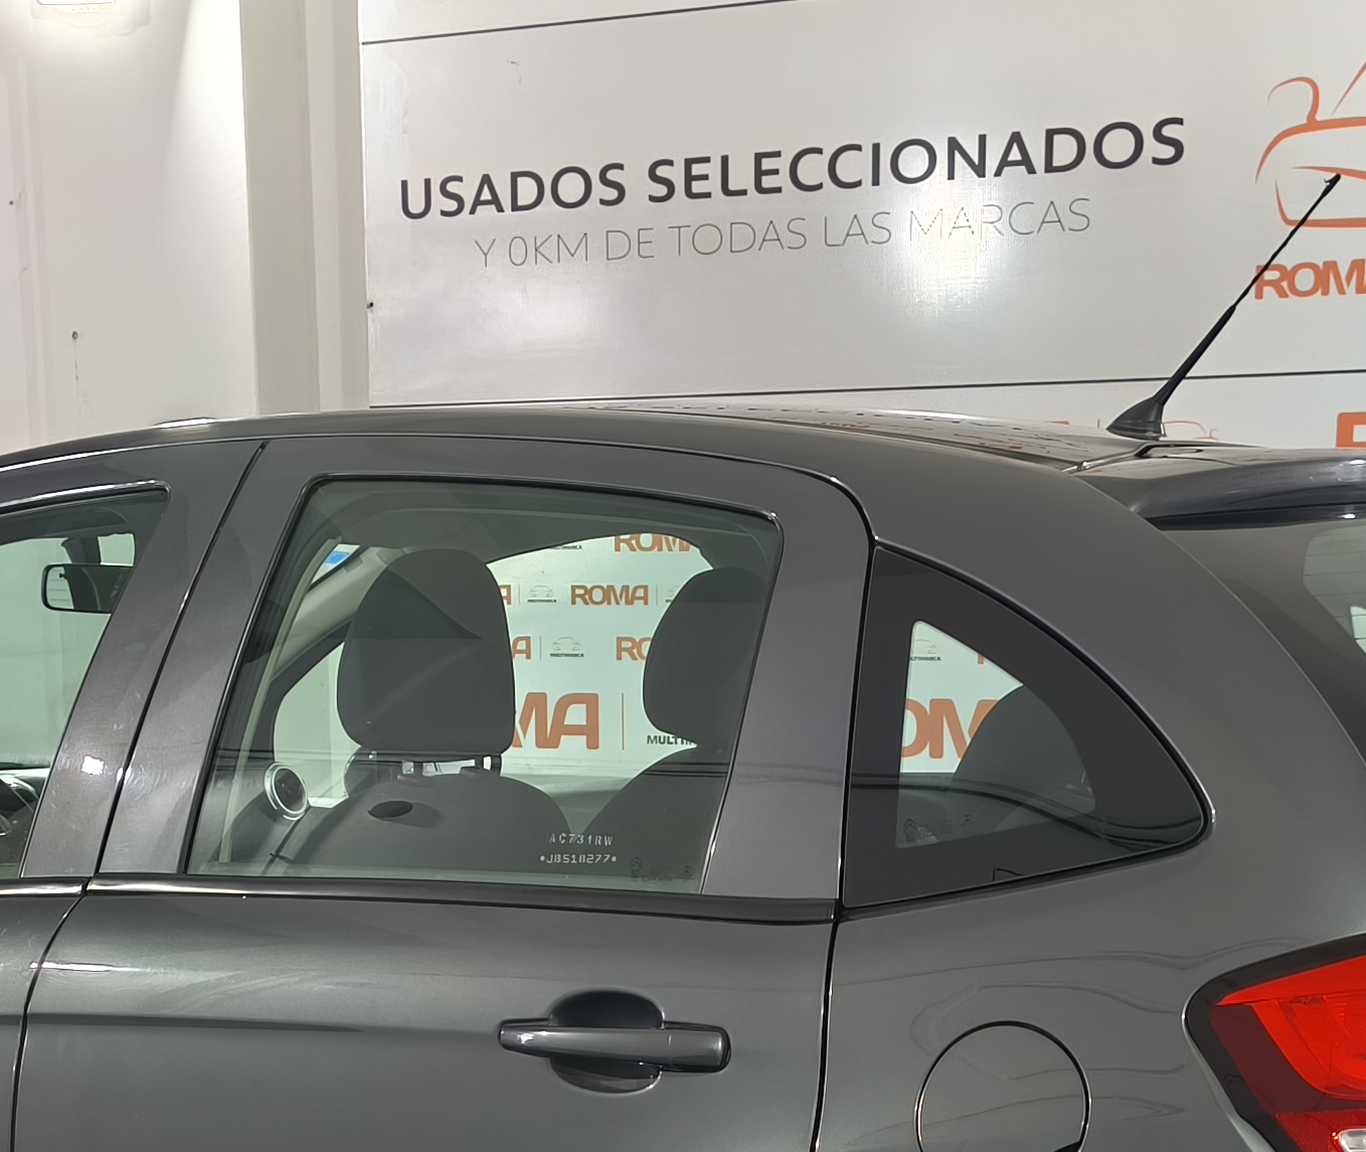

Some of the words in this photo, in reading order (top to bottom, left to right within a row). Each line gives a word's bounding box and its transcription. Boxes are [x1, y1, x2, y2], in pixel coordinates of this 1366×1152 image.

[400, 162, 627, 220] USADOS
[647, 116, 1186, 203] SELECCIONADOS
[474, 237, 497, 268] Y
[605, 227, 655, 262] DE
[667, 217, 808, 256] TODAS
[824, 211, 892, 248] LAS
[909, 197, 1091, 242] MARCAS
[571, 584, 649, 606] ROMA
